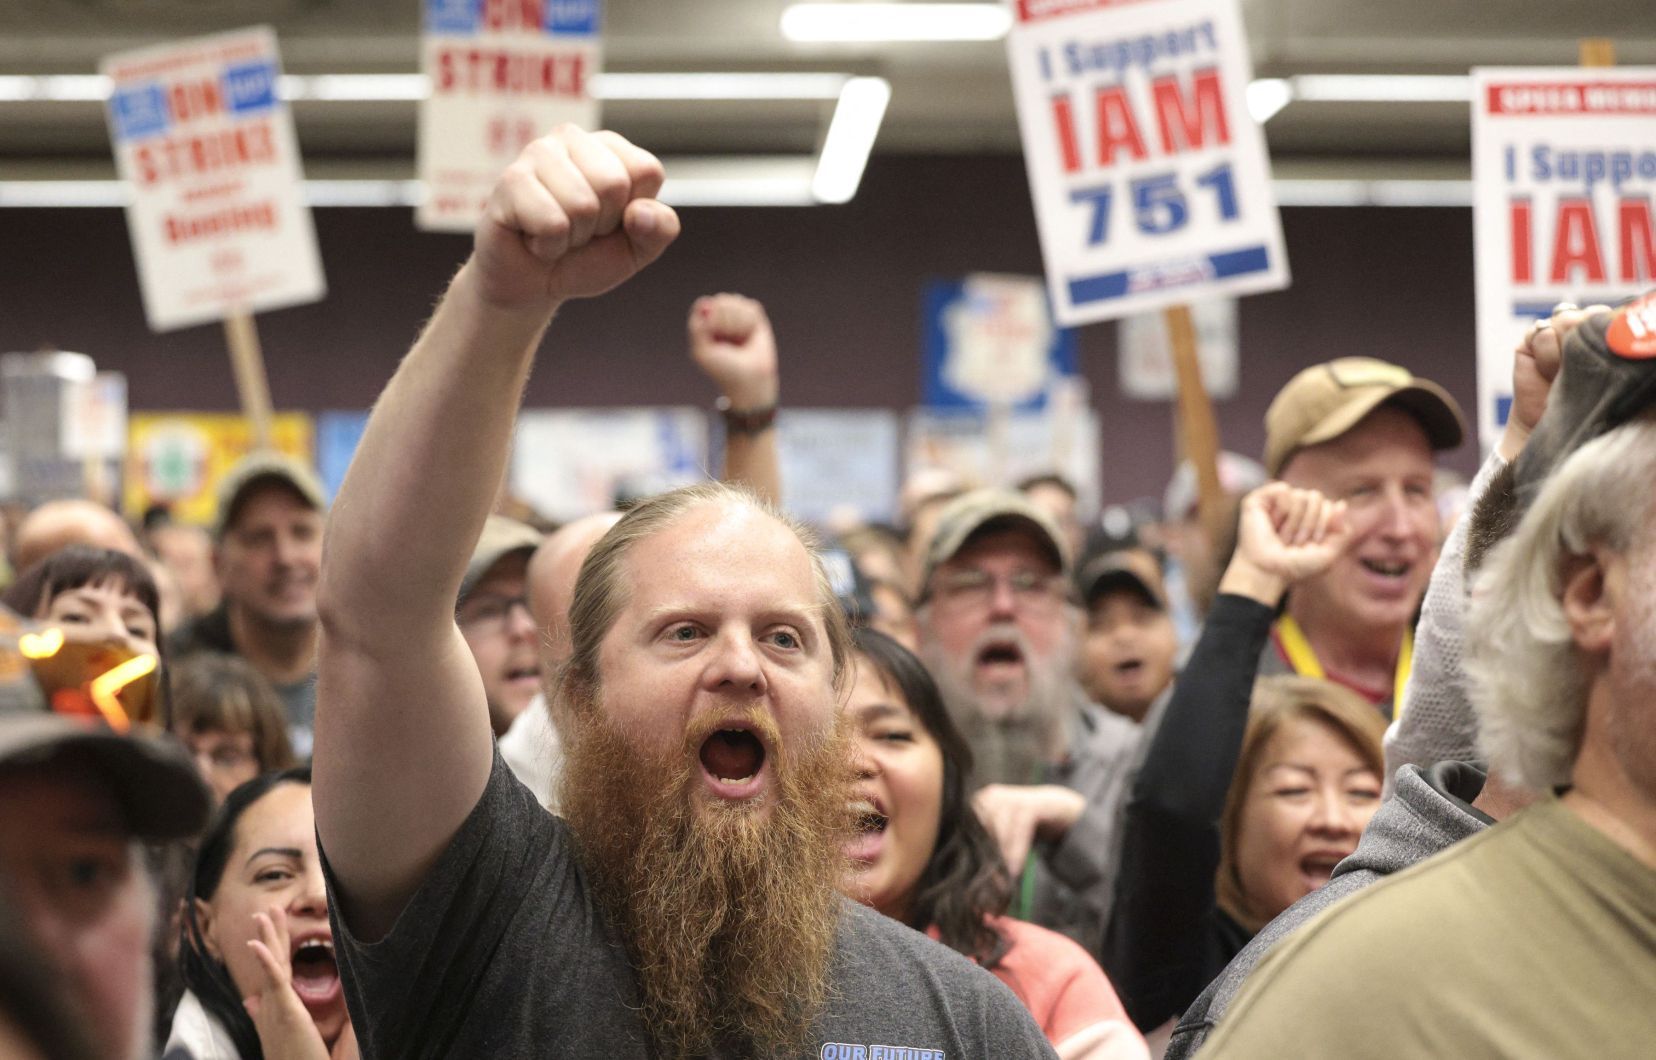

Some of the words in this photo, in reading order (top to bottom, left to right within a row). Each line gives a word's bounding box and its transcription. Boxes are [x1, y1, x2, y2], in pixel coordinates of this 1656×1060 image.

[437, 48, 585, 97] STRIKE
[1063, 20, 1216, 82] Support
[1052, 66, 1231, 174] IAM
[135, 122, 275, 186] STRIKE
[1068, 163, 1239, 247] 751
[822, 1044, 867, 1060] OUR
